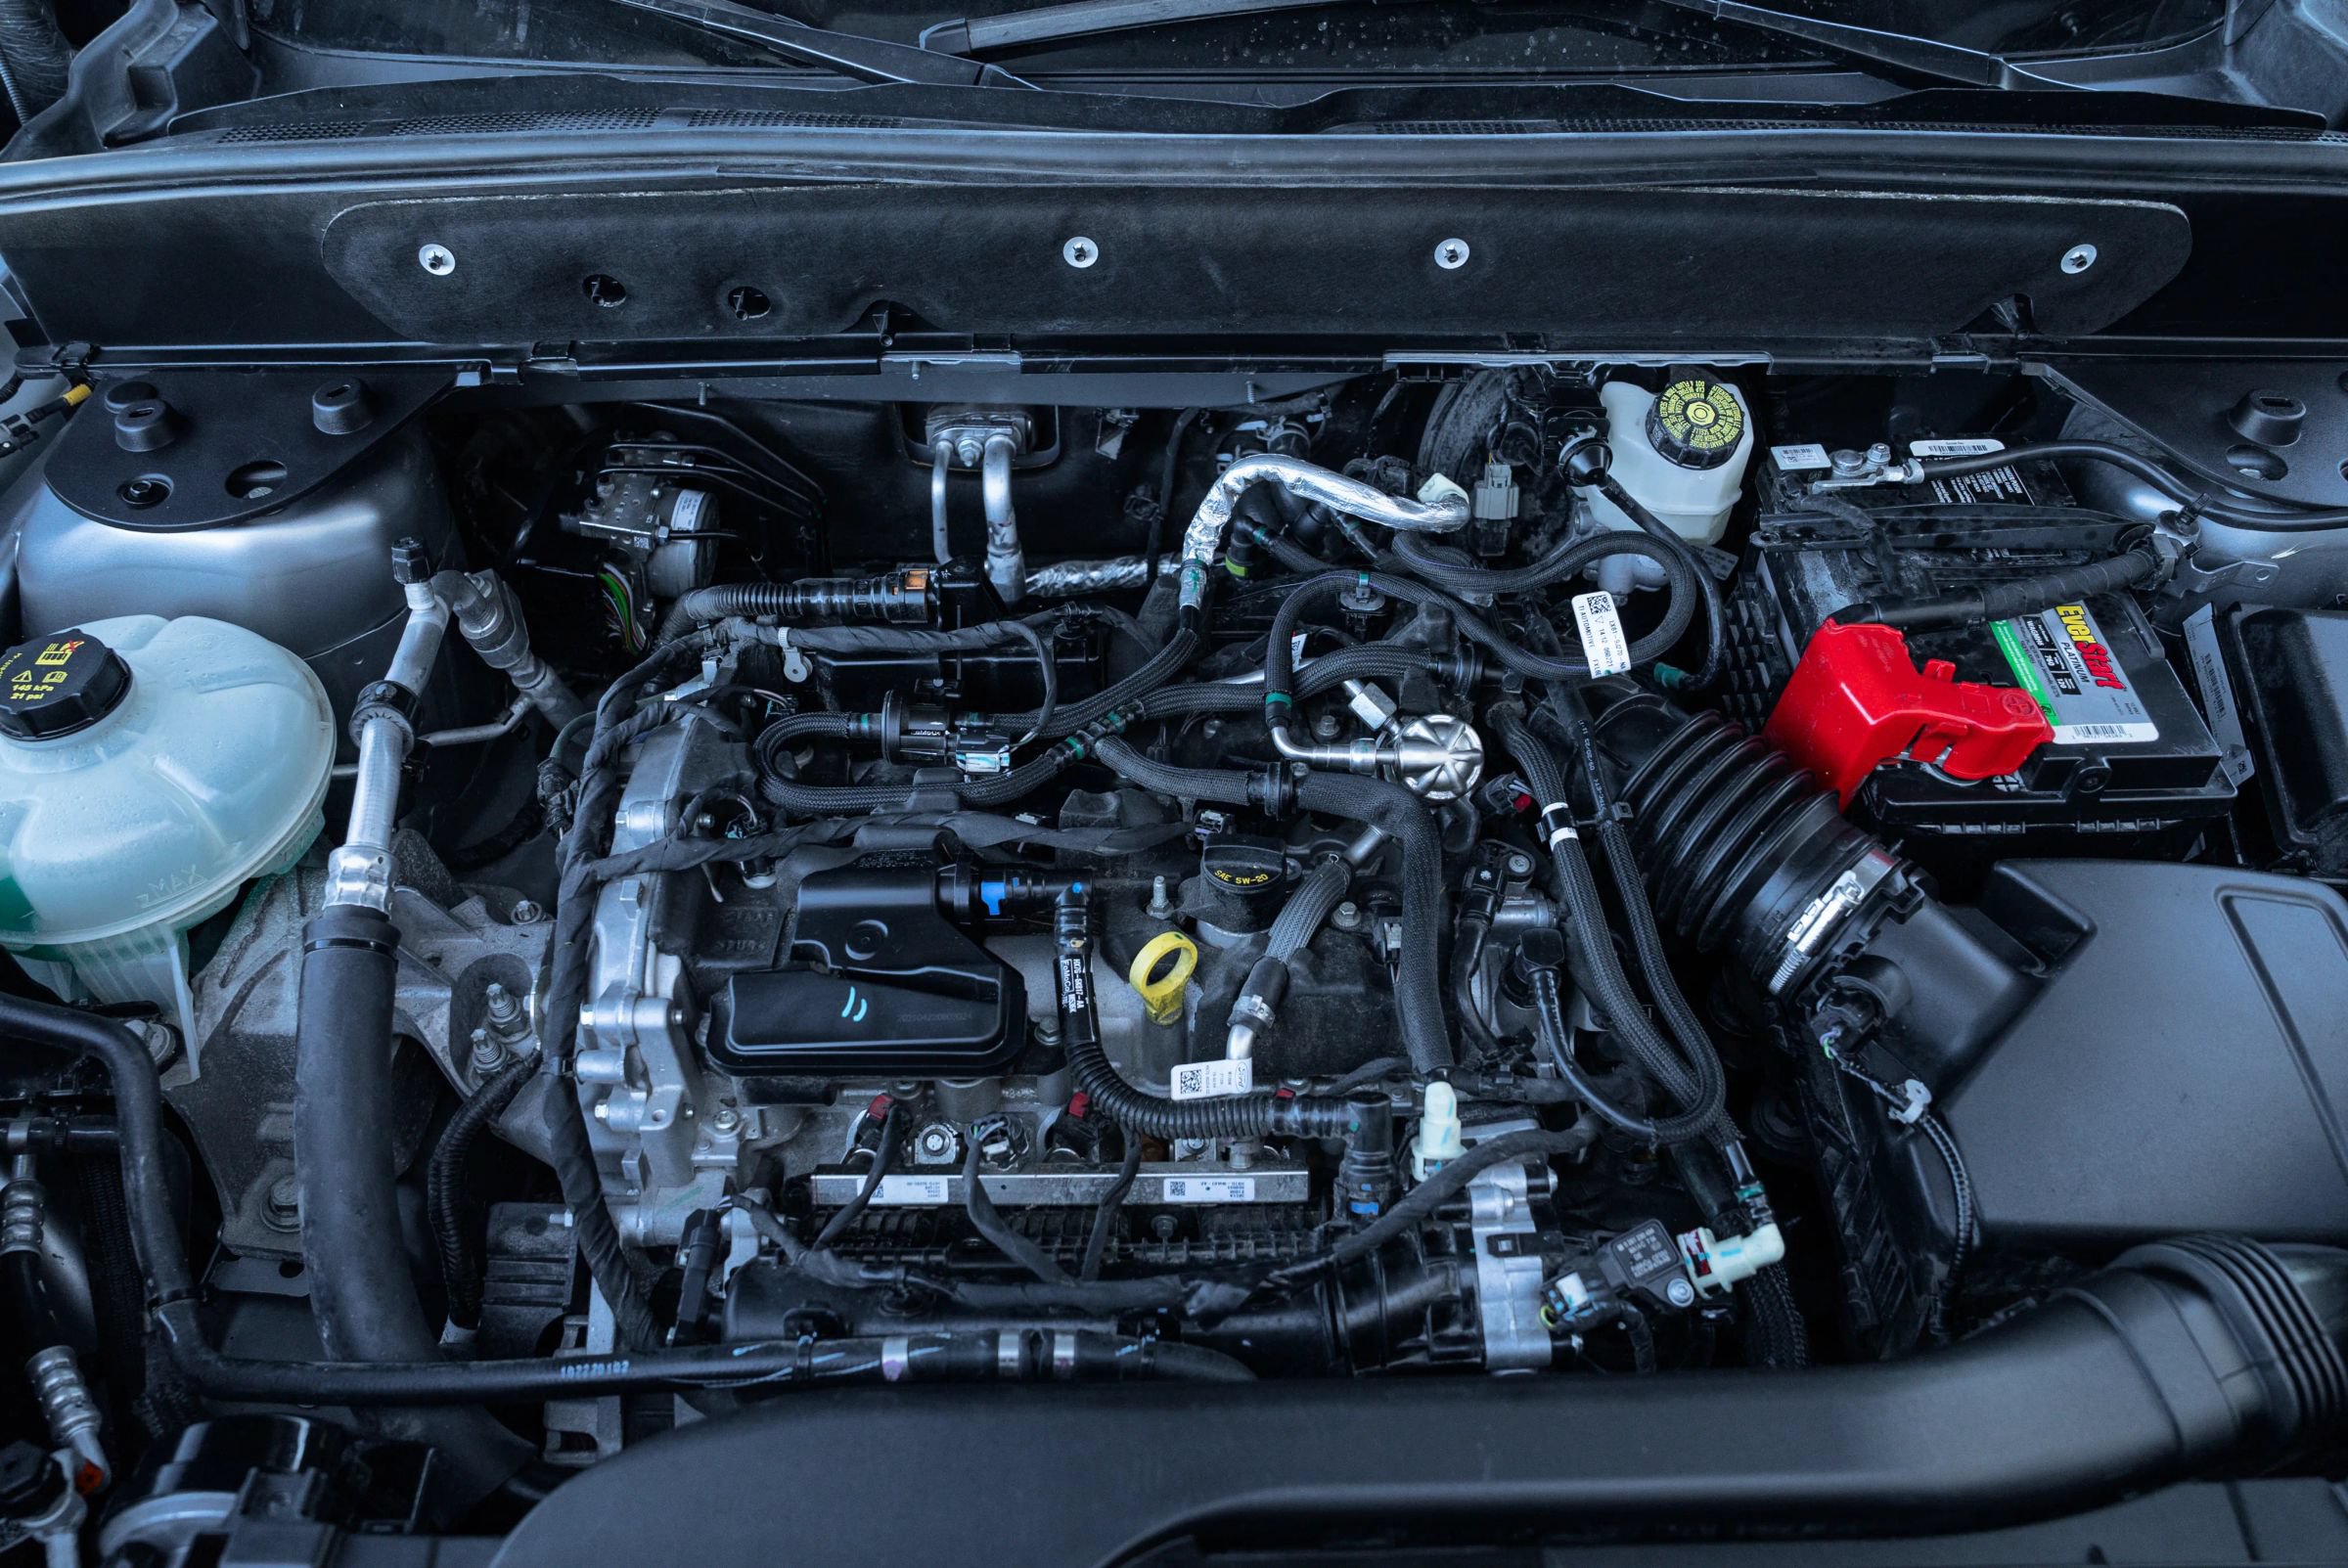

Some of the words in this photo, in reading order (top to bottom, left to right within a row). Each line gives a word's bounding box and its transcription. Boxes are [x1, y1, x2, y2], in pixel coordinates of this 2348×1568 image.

[2055, 605, 2125, 691] EverStart
[2061, 642, 2091, 683] PLATINUM
[1214, 870, 1232, 882] SAE
[1235, 874, 1269, 885] 5W-20
